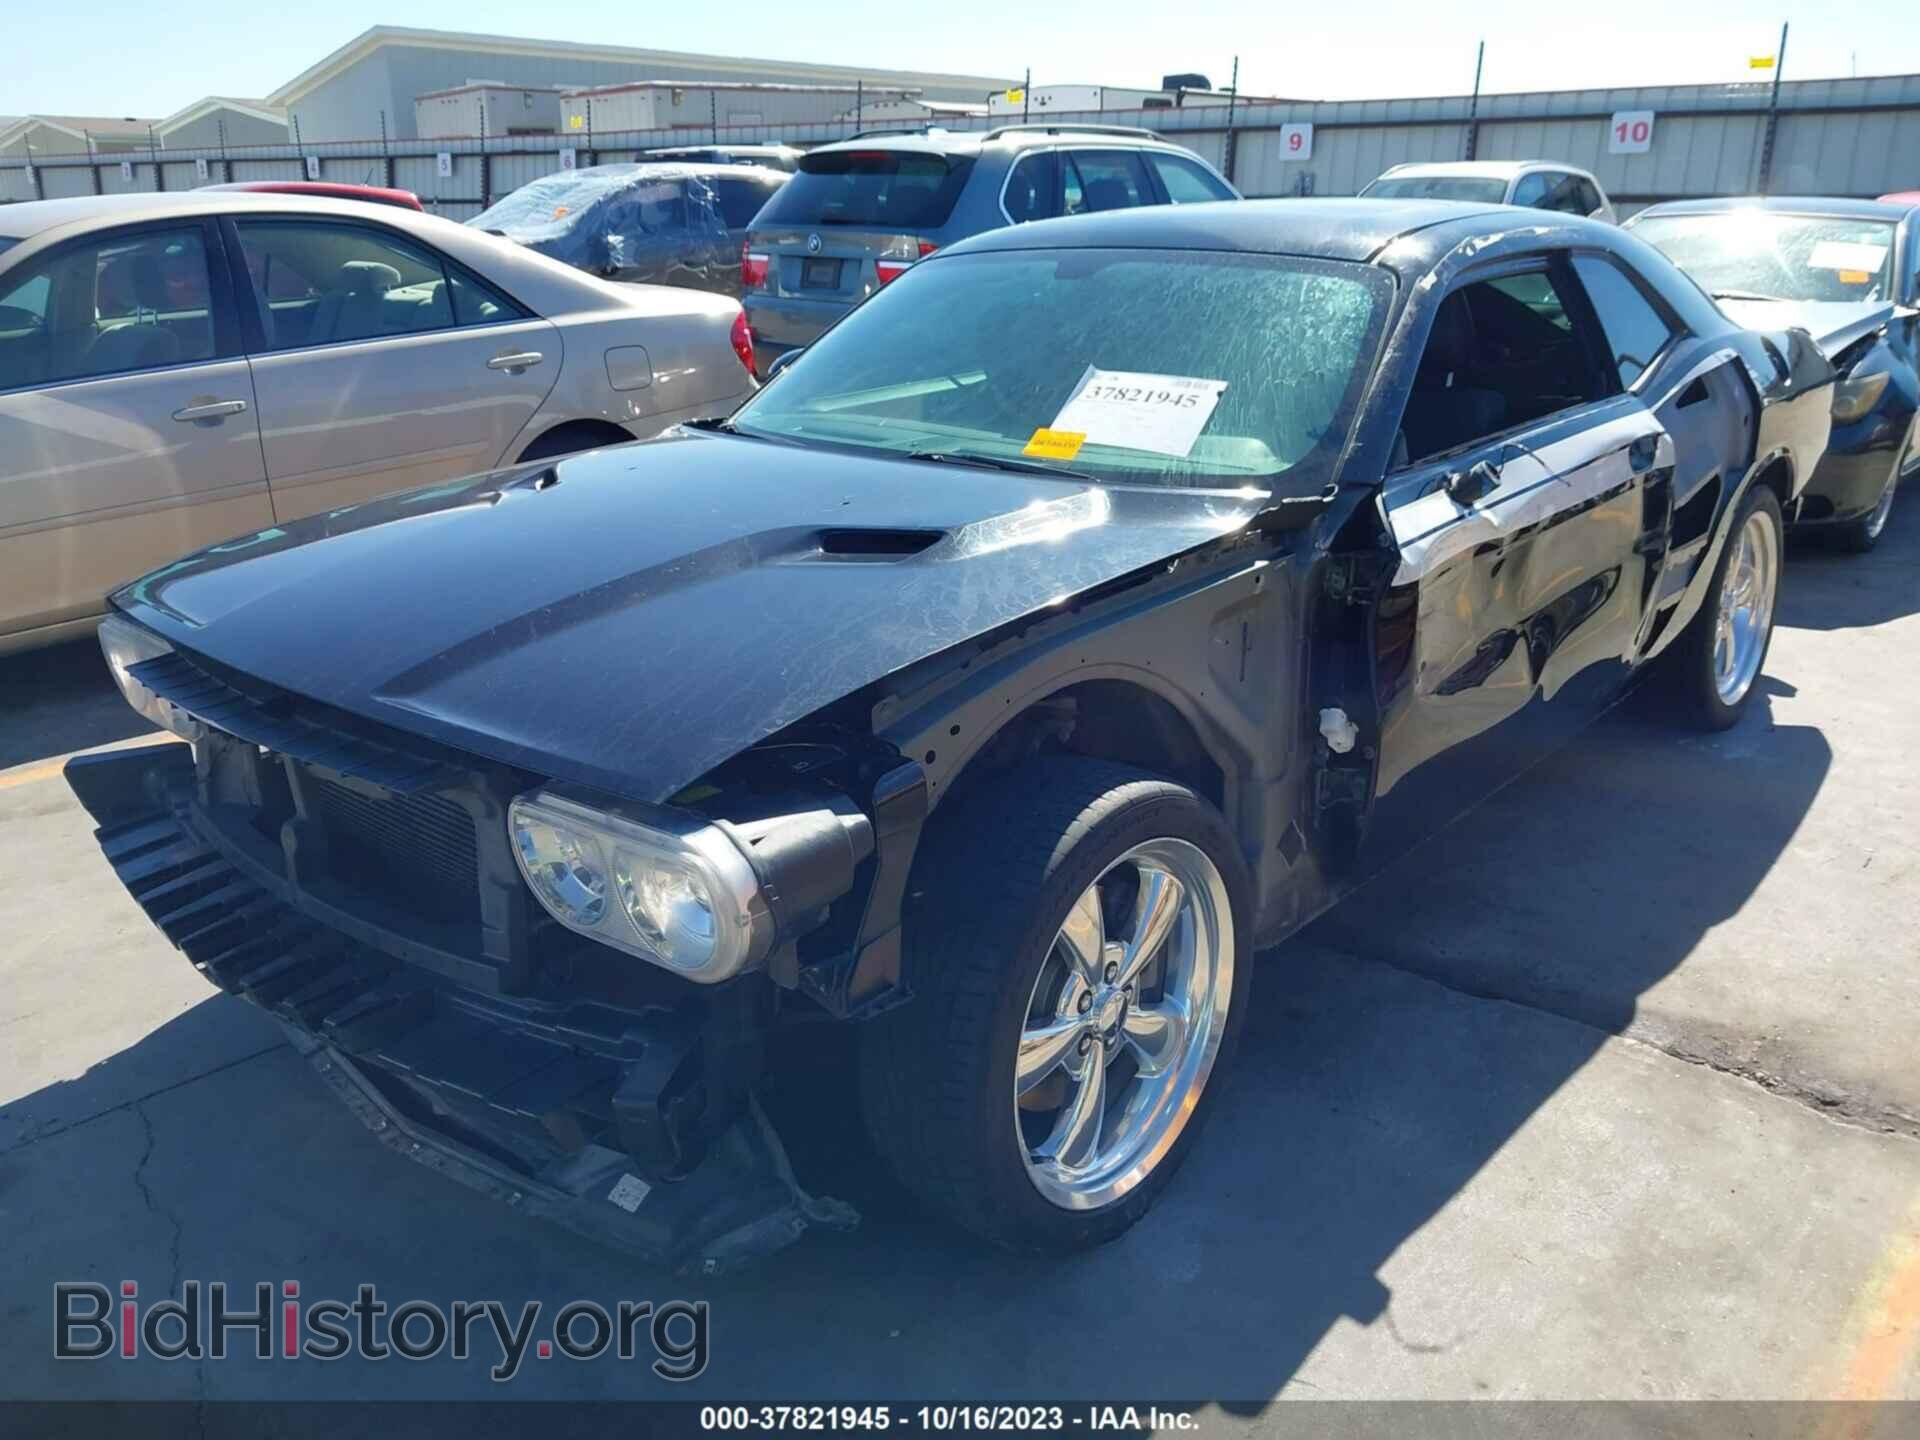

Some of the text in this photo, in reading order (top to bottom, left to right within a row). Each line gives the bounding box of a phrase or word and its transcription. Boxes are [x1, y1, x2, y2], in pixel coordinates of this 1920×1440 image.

[1289, 132, 1303, 151] 9
[1615, 121, 1649, 144] 10
[1086, 386, 1200, 408] 37821945
